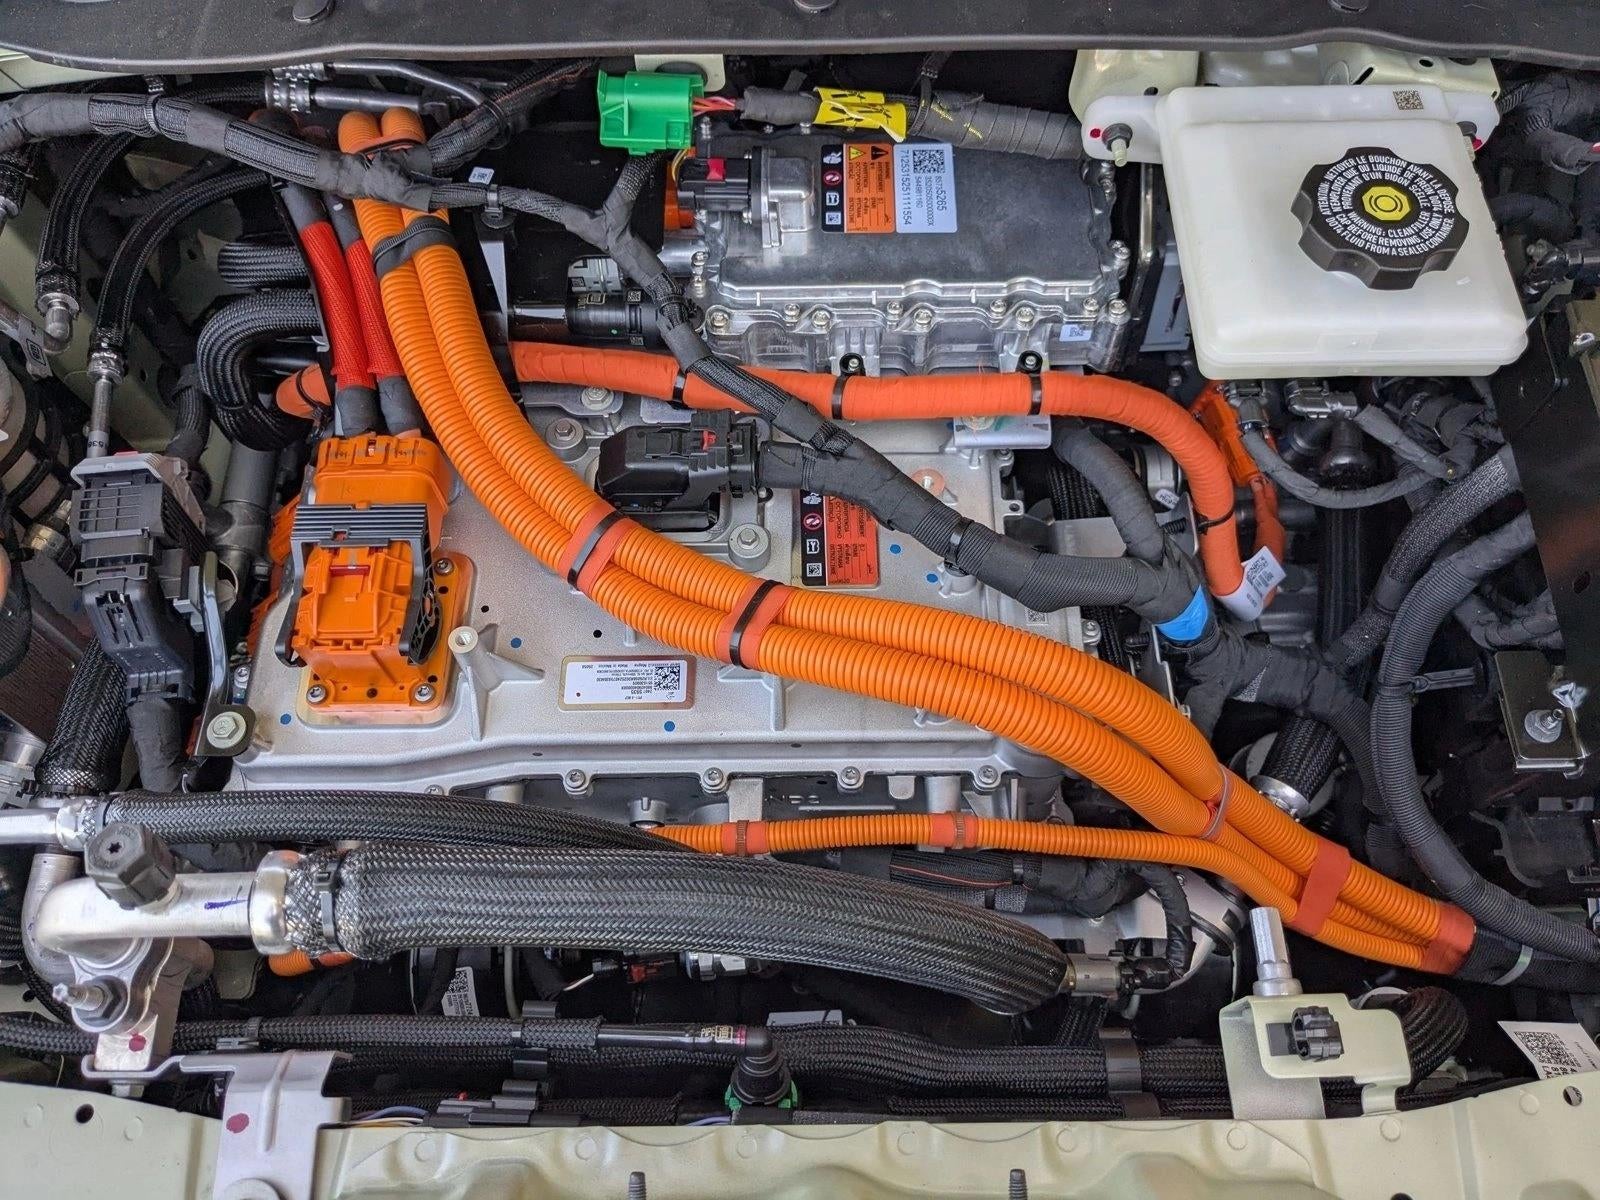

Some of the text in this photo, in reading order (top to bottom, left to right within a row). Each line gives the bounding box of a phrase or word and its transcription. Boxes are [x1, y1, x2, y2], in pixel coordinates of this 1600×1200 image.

[1325, 159, 1357, 181] NETTOYER
[1357, 156, 1367, 165] LE
[1368, 155, 1408, 168] BOUCHON
[1408, 164, 1435, 181] AVANT
[1430, 178, 1439, 189] LA
[1437, 187, 1455, 214] DEPOSE
[1341, 172, 1430, 210] PROVENANT D'UN BIDON SCELLE
[1343, 169, 1360, 179] QUE
[1360, 165, 1370, 173] DU
[1372, 163, 1402, 176] LIQUIDE
[1403, 171, 1415, 181] DE
[1414, 177, 1435, 196] FREIN
[1428, 193, 1443, 211] DOT4
[1325, 216, 1342, 235] DOT4
[1341, 230, 1365, 247] FLUID
[1365, 242, 1390, 255] FROM
[1391, 247, 1397, 256] A
[1397, 243, 1429, 257] SEALED
[1335, 211, 1351, 226] CAP
[1348, 221, 1378, 243] BEFORE
[1420, 227, 1436, 240] USE
[1430, 212, 1443, 233] ONLY
[1347, 211, 1431, 238] WARNING: CLEAN FILLER
